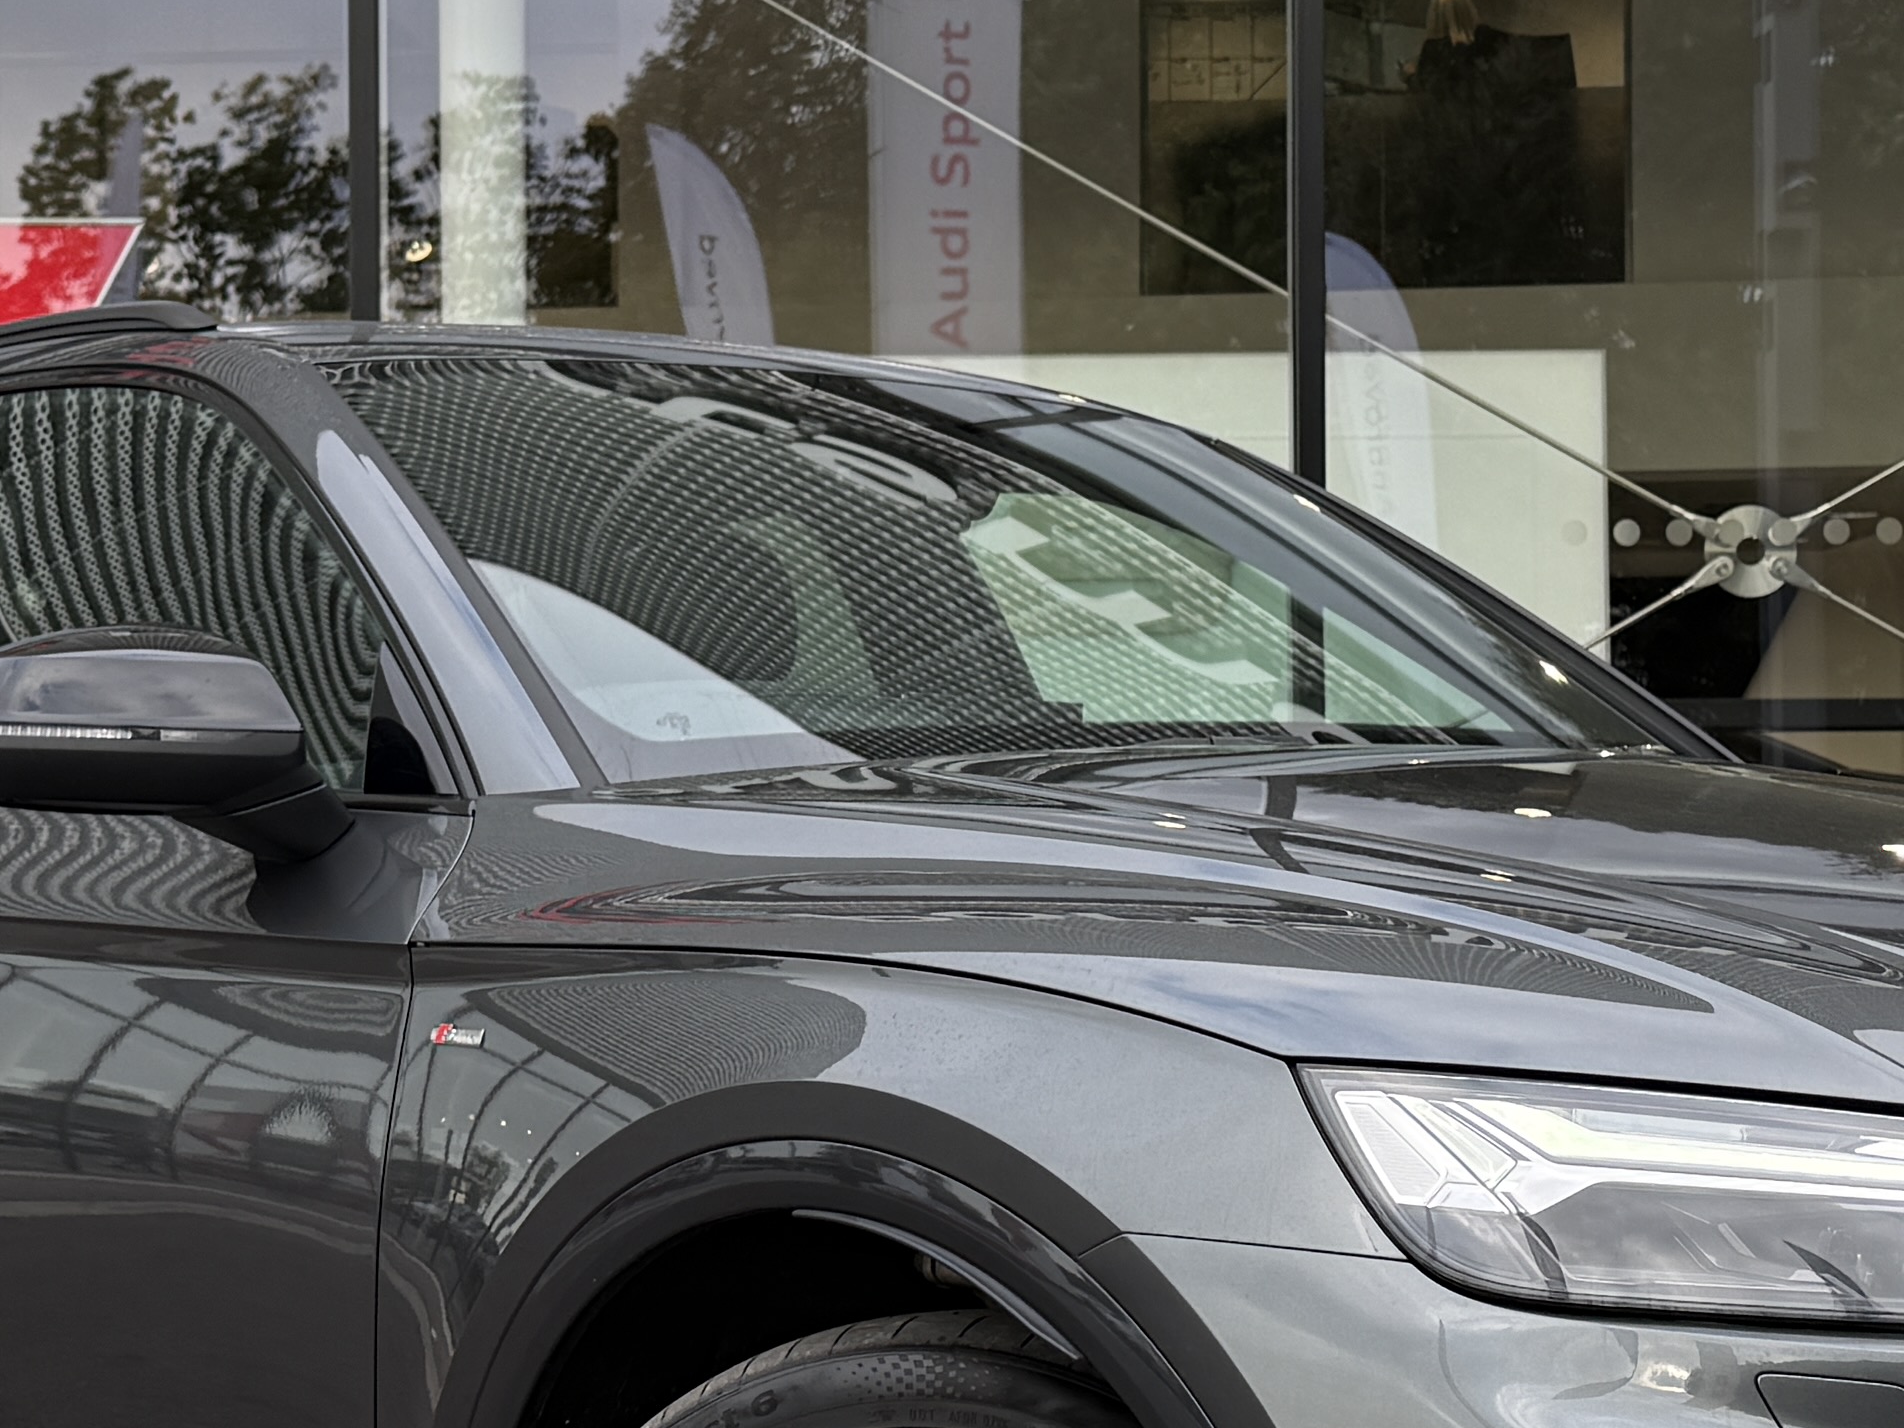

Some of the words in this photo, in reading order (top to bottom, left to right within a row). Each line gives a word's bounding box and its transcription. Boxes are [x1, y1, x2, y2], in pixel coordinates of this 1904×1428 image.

[930, 18, 981, 188] Sport
[929, 208, 971, 349] Audi
[750, 1388, 782, 1419] 6
